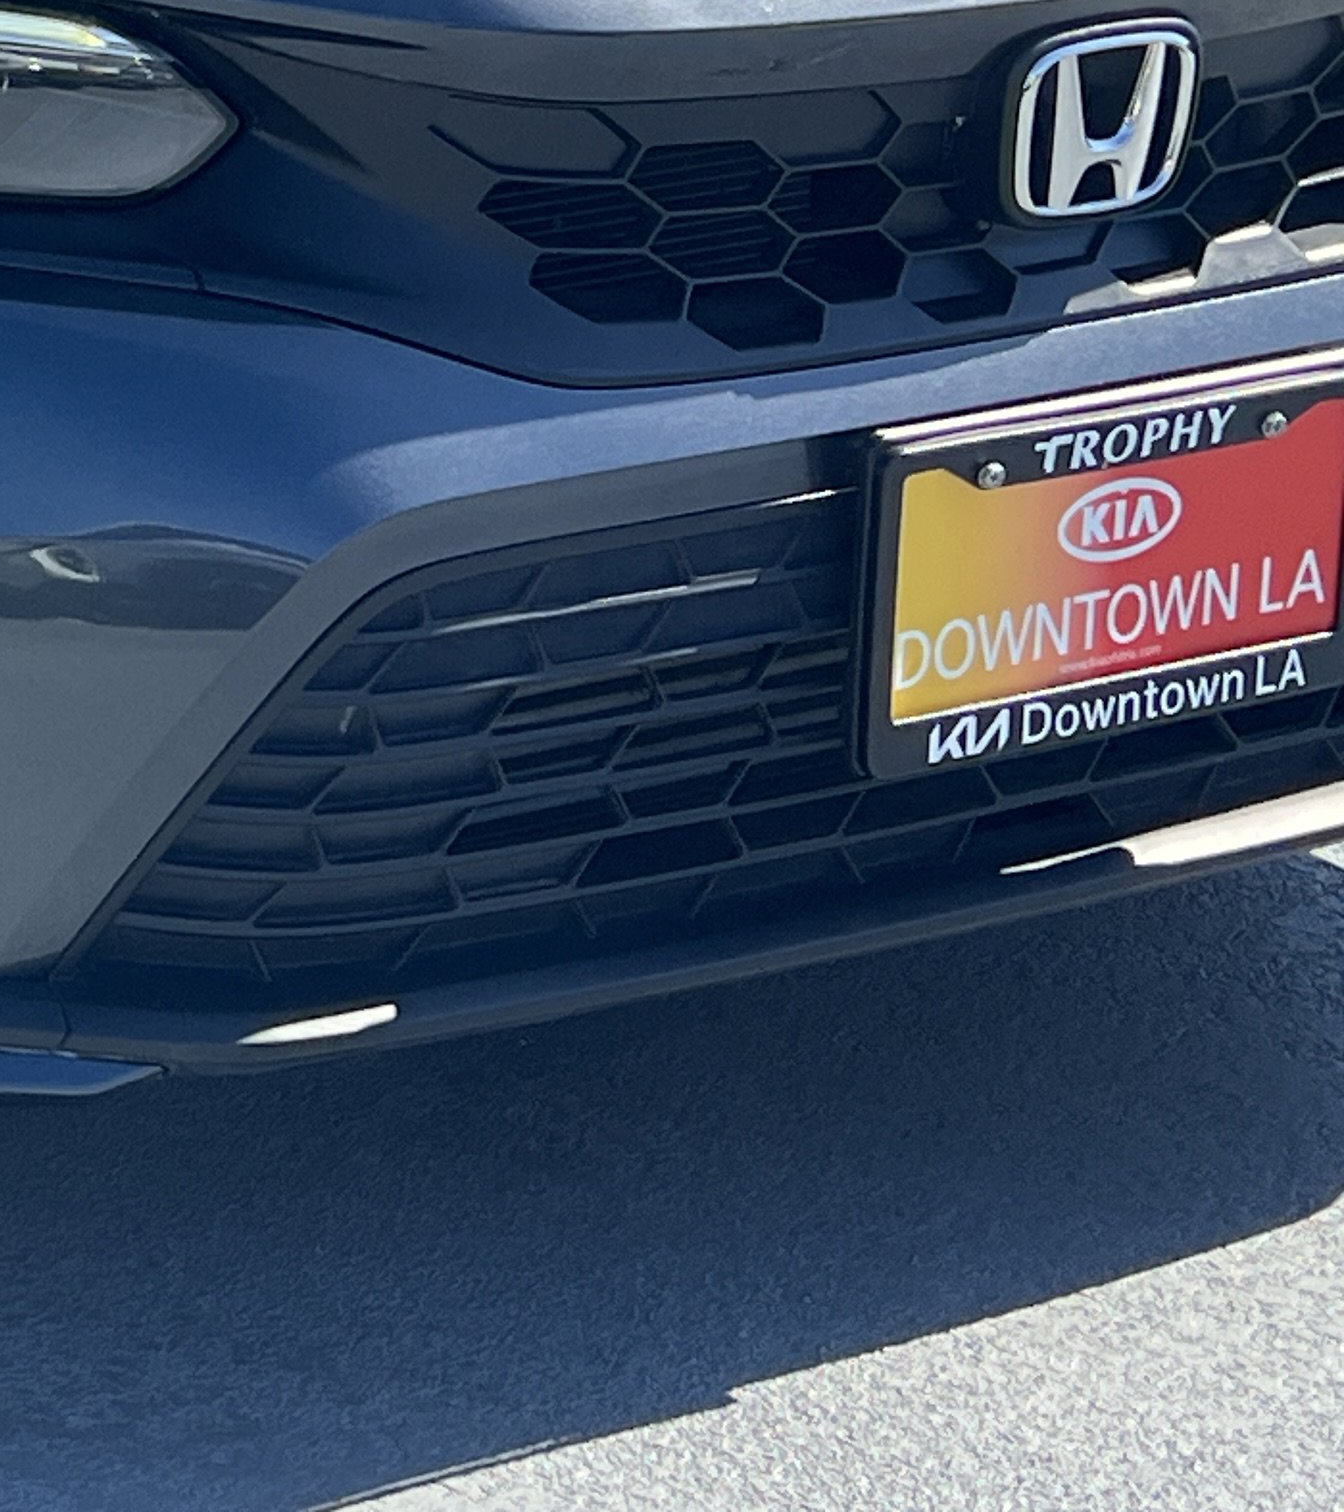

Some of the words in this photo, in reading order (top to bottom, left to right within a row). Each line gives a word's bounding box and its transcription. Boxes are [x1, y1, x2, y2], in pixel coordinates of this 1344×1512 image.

[1034, 404, 1237, 474] TROPHY
[1080, 494, 1160, 547] KIA
[895, 562, 1241, 690] DOWNTOWN
[1258, 548, 1326, 615] LA
[1020, 668, 1245, 746] Downtown
[1254, 648, 1308, 698] LA
